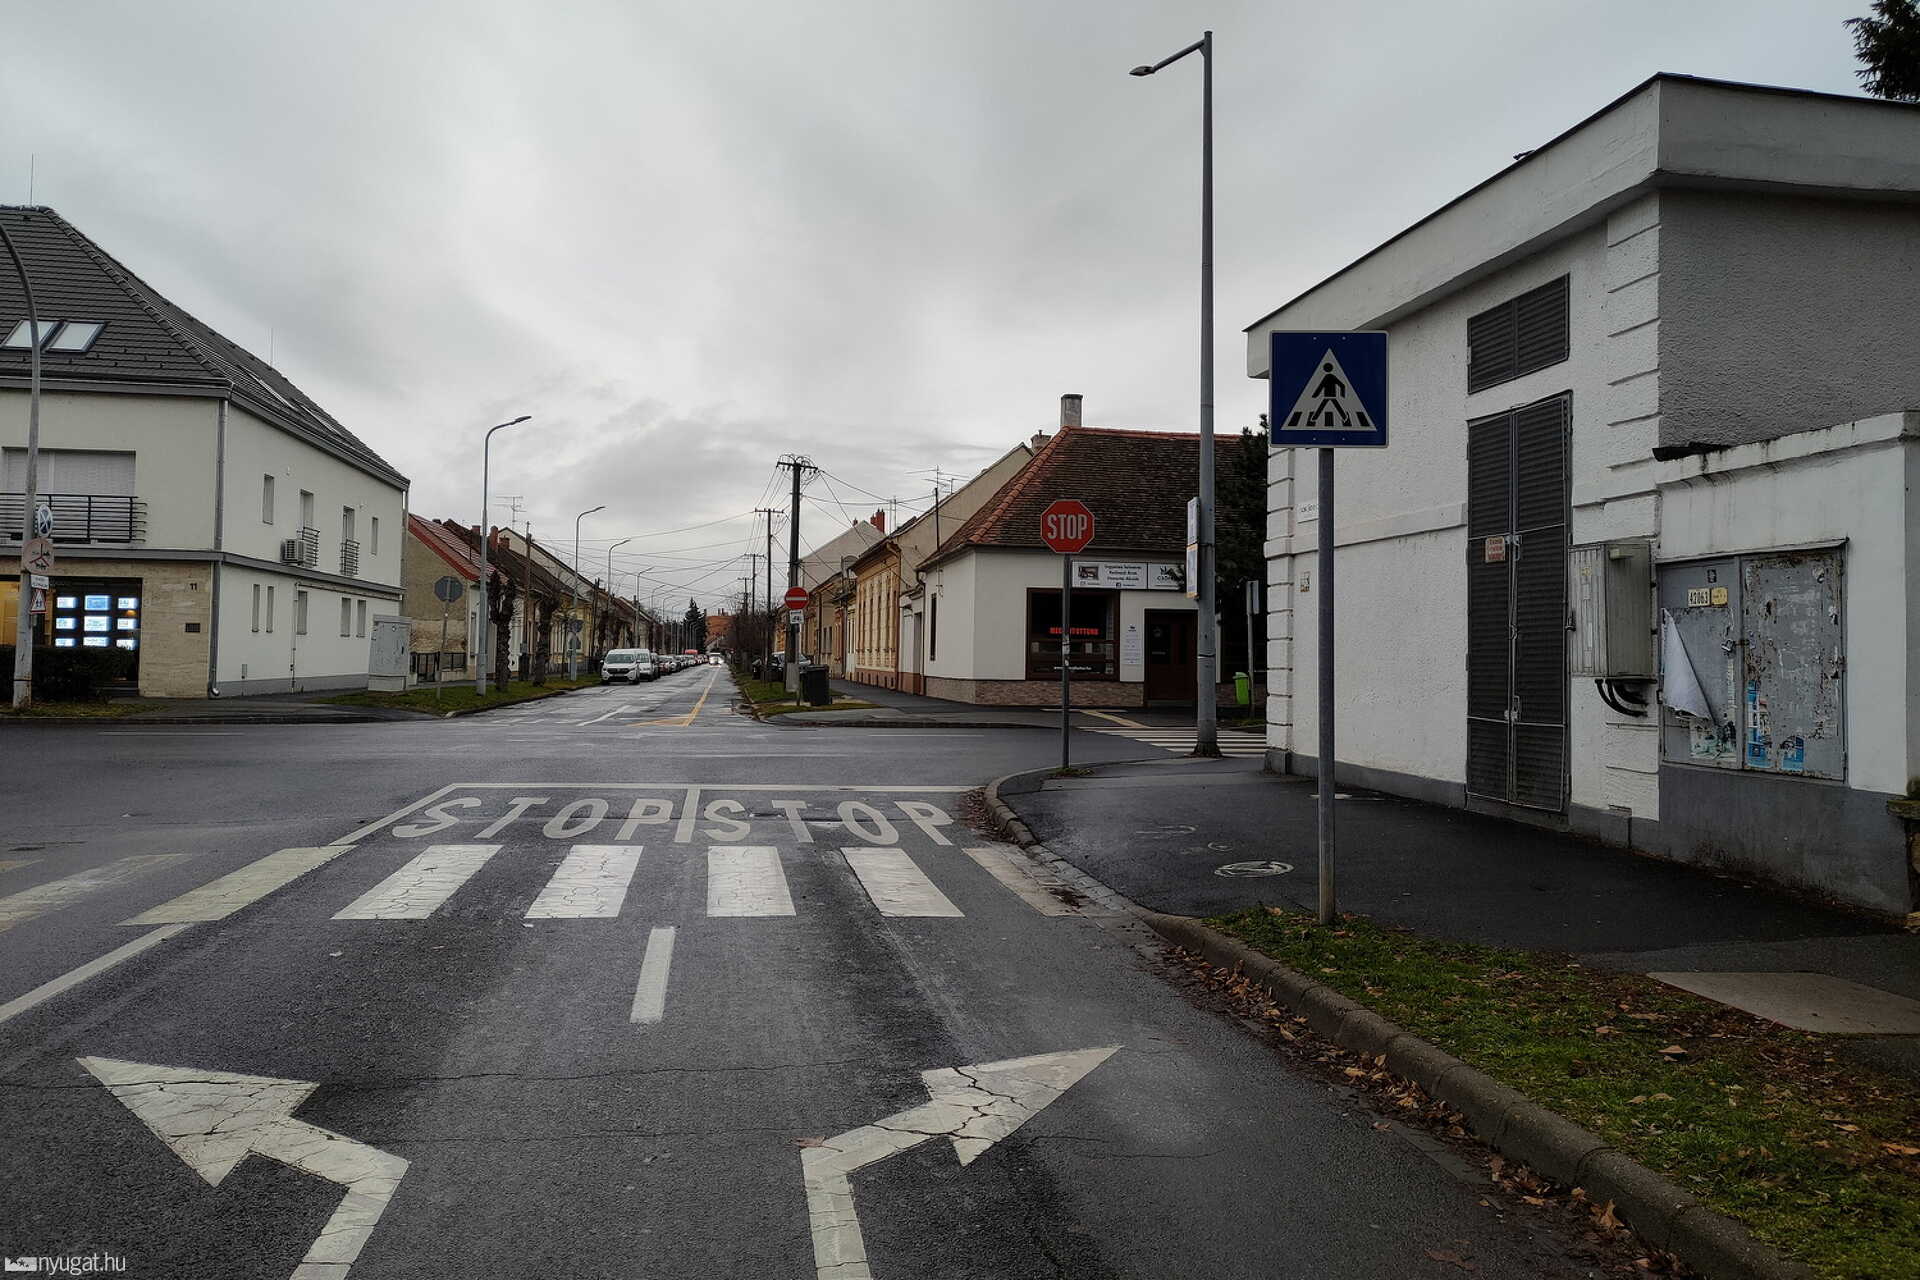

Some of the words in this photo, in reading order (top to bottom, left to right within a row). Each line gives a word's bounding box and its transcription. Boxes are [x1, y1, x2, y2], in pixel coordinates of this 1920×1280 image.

[1047, 514, 1088, 540] STOP
[189, 582, 198, 591] 11
[393, 797, 671, 841] STOP
[702, 799, 954, 846] STOP
